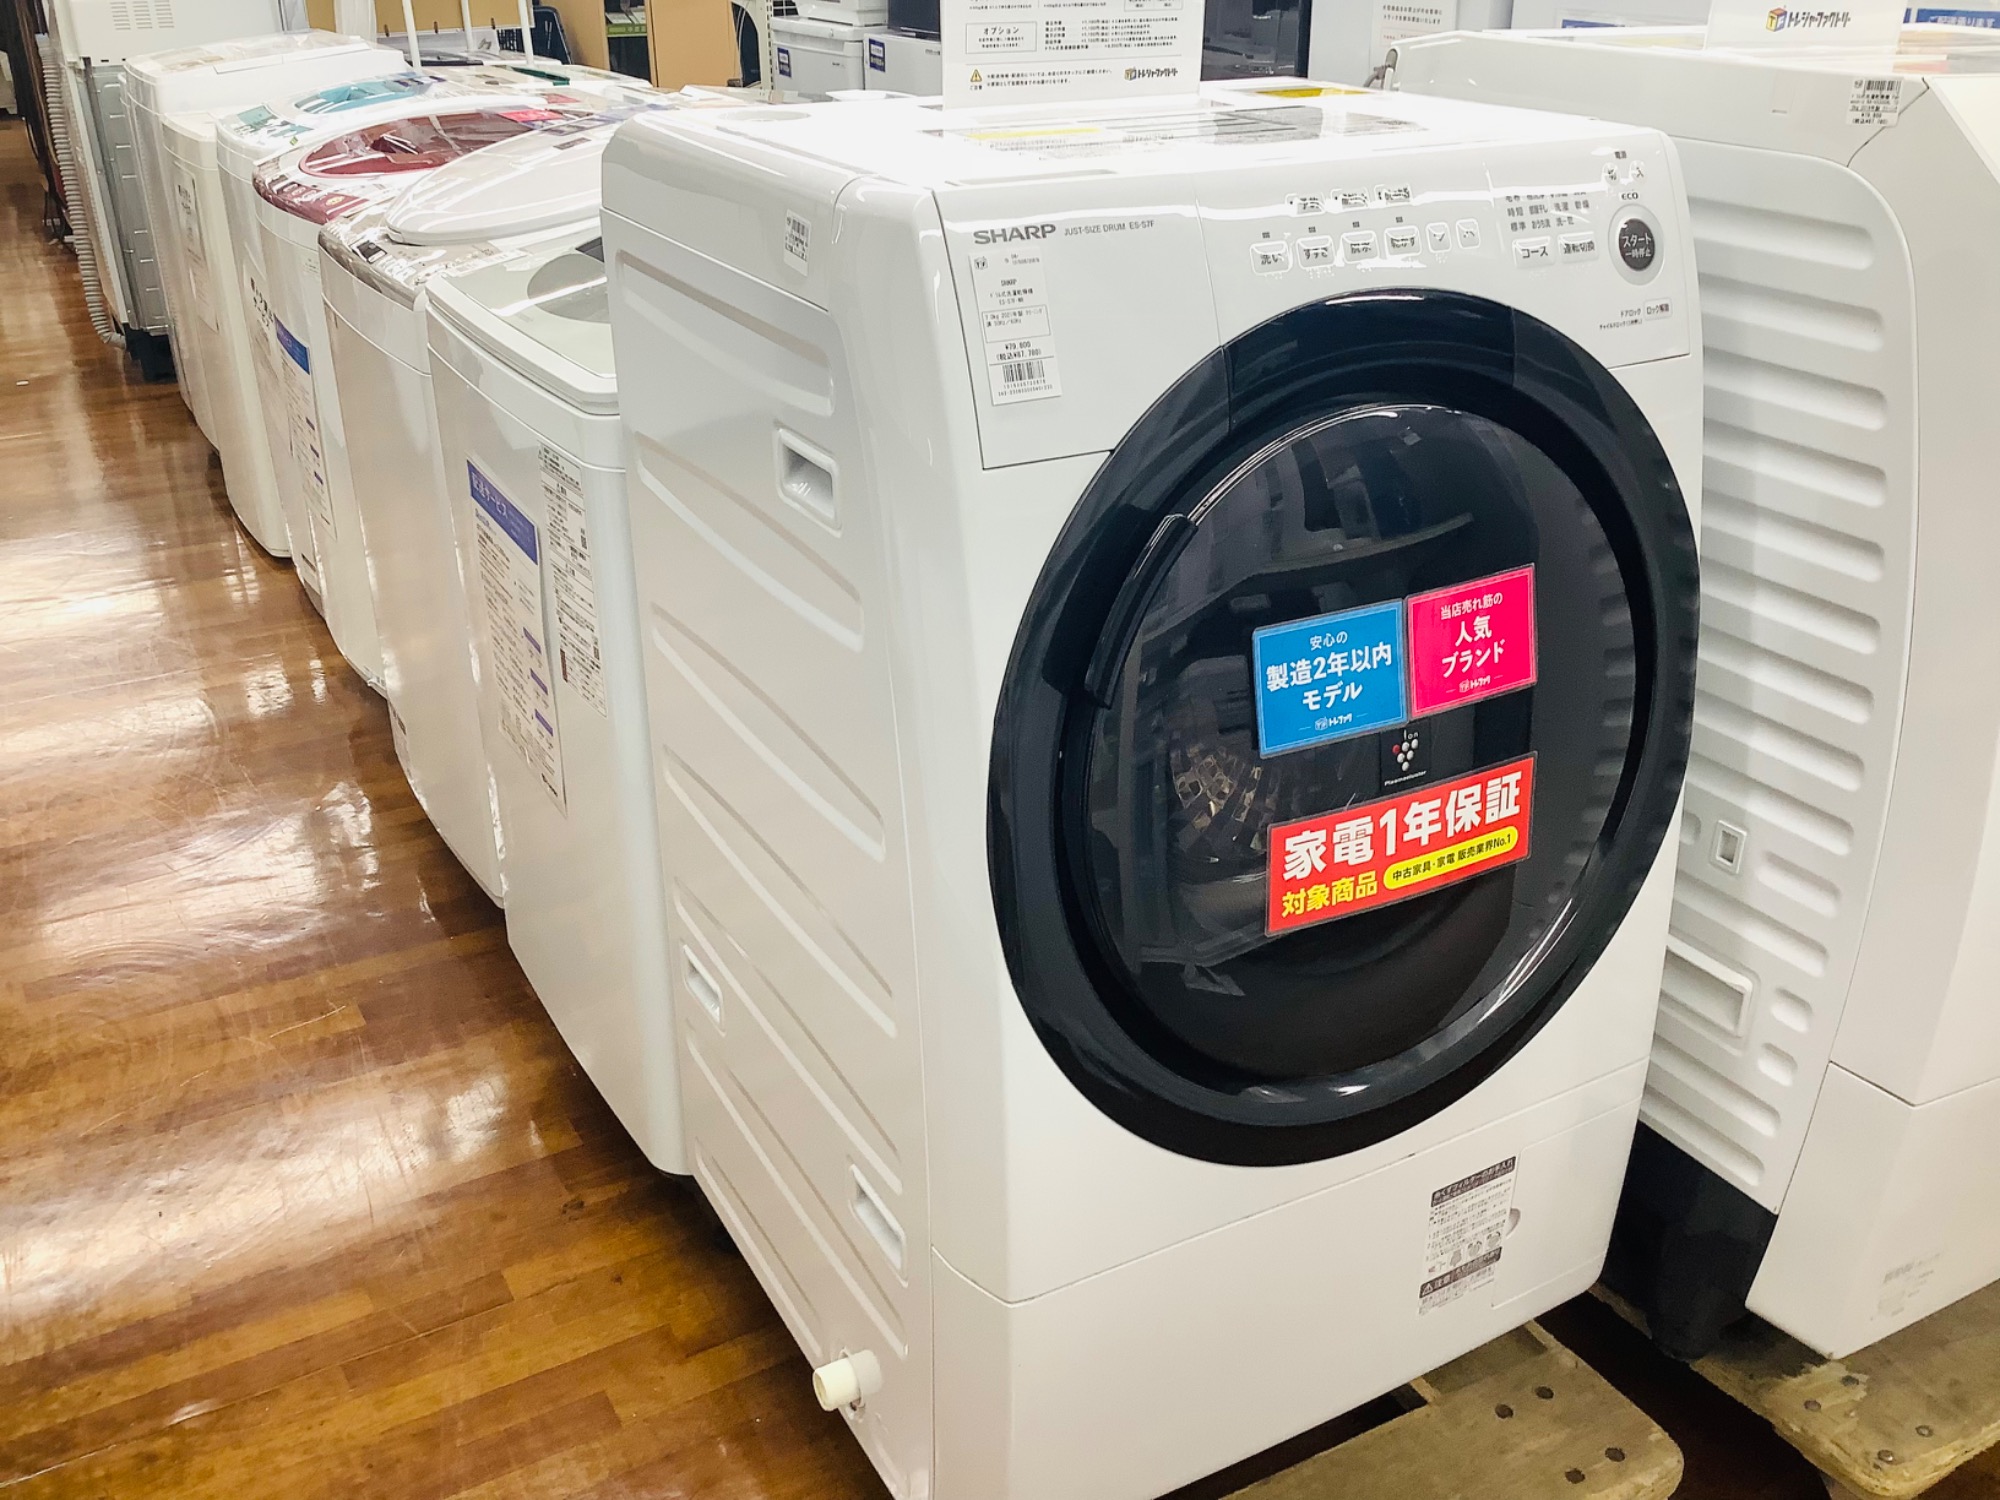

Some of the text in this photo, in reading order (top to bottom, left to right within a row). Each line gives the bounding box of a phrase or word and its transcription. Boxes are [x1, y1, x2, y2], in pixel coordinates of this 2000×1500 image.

[973, 223, 1056, 245] SHARP
[1064, 220, 1155, 236] JUST-SIZE DRUM ES-S7F
[1621, 233, 1652, 248] スタート
[1521, 246, 1548, 259] コース
[1625, 248, 1652, 258] 一時停止
[1440, 592, 1503, 620] 当店売れ筋の
[1309, 630, 1348, 650] 安心の
[1454, 614, 1493, 647] 人気
[1266, 641, 1393, 692] 製造2年以内
[1441, 638, 1506, 678] ブランド
[1302, 681, 1363, 711] モデル
[1282, 771, 1523, 881] 家電1年保証
[1392, 836, 1511, 881] 中古家具・家電 販売業界No.1
[1281, 871, 1378, 918] 対象商品
